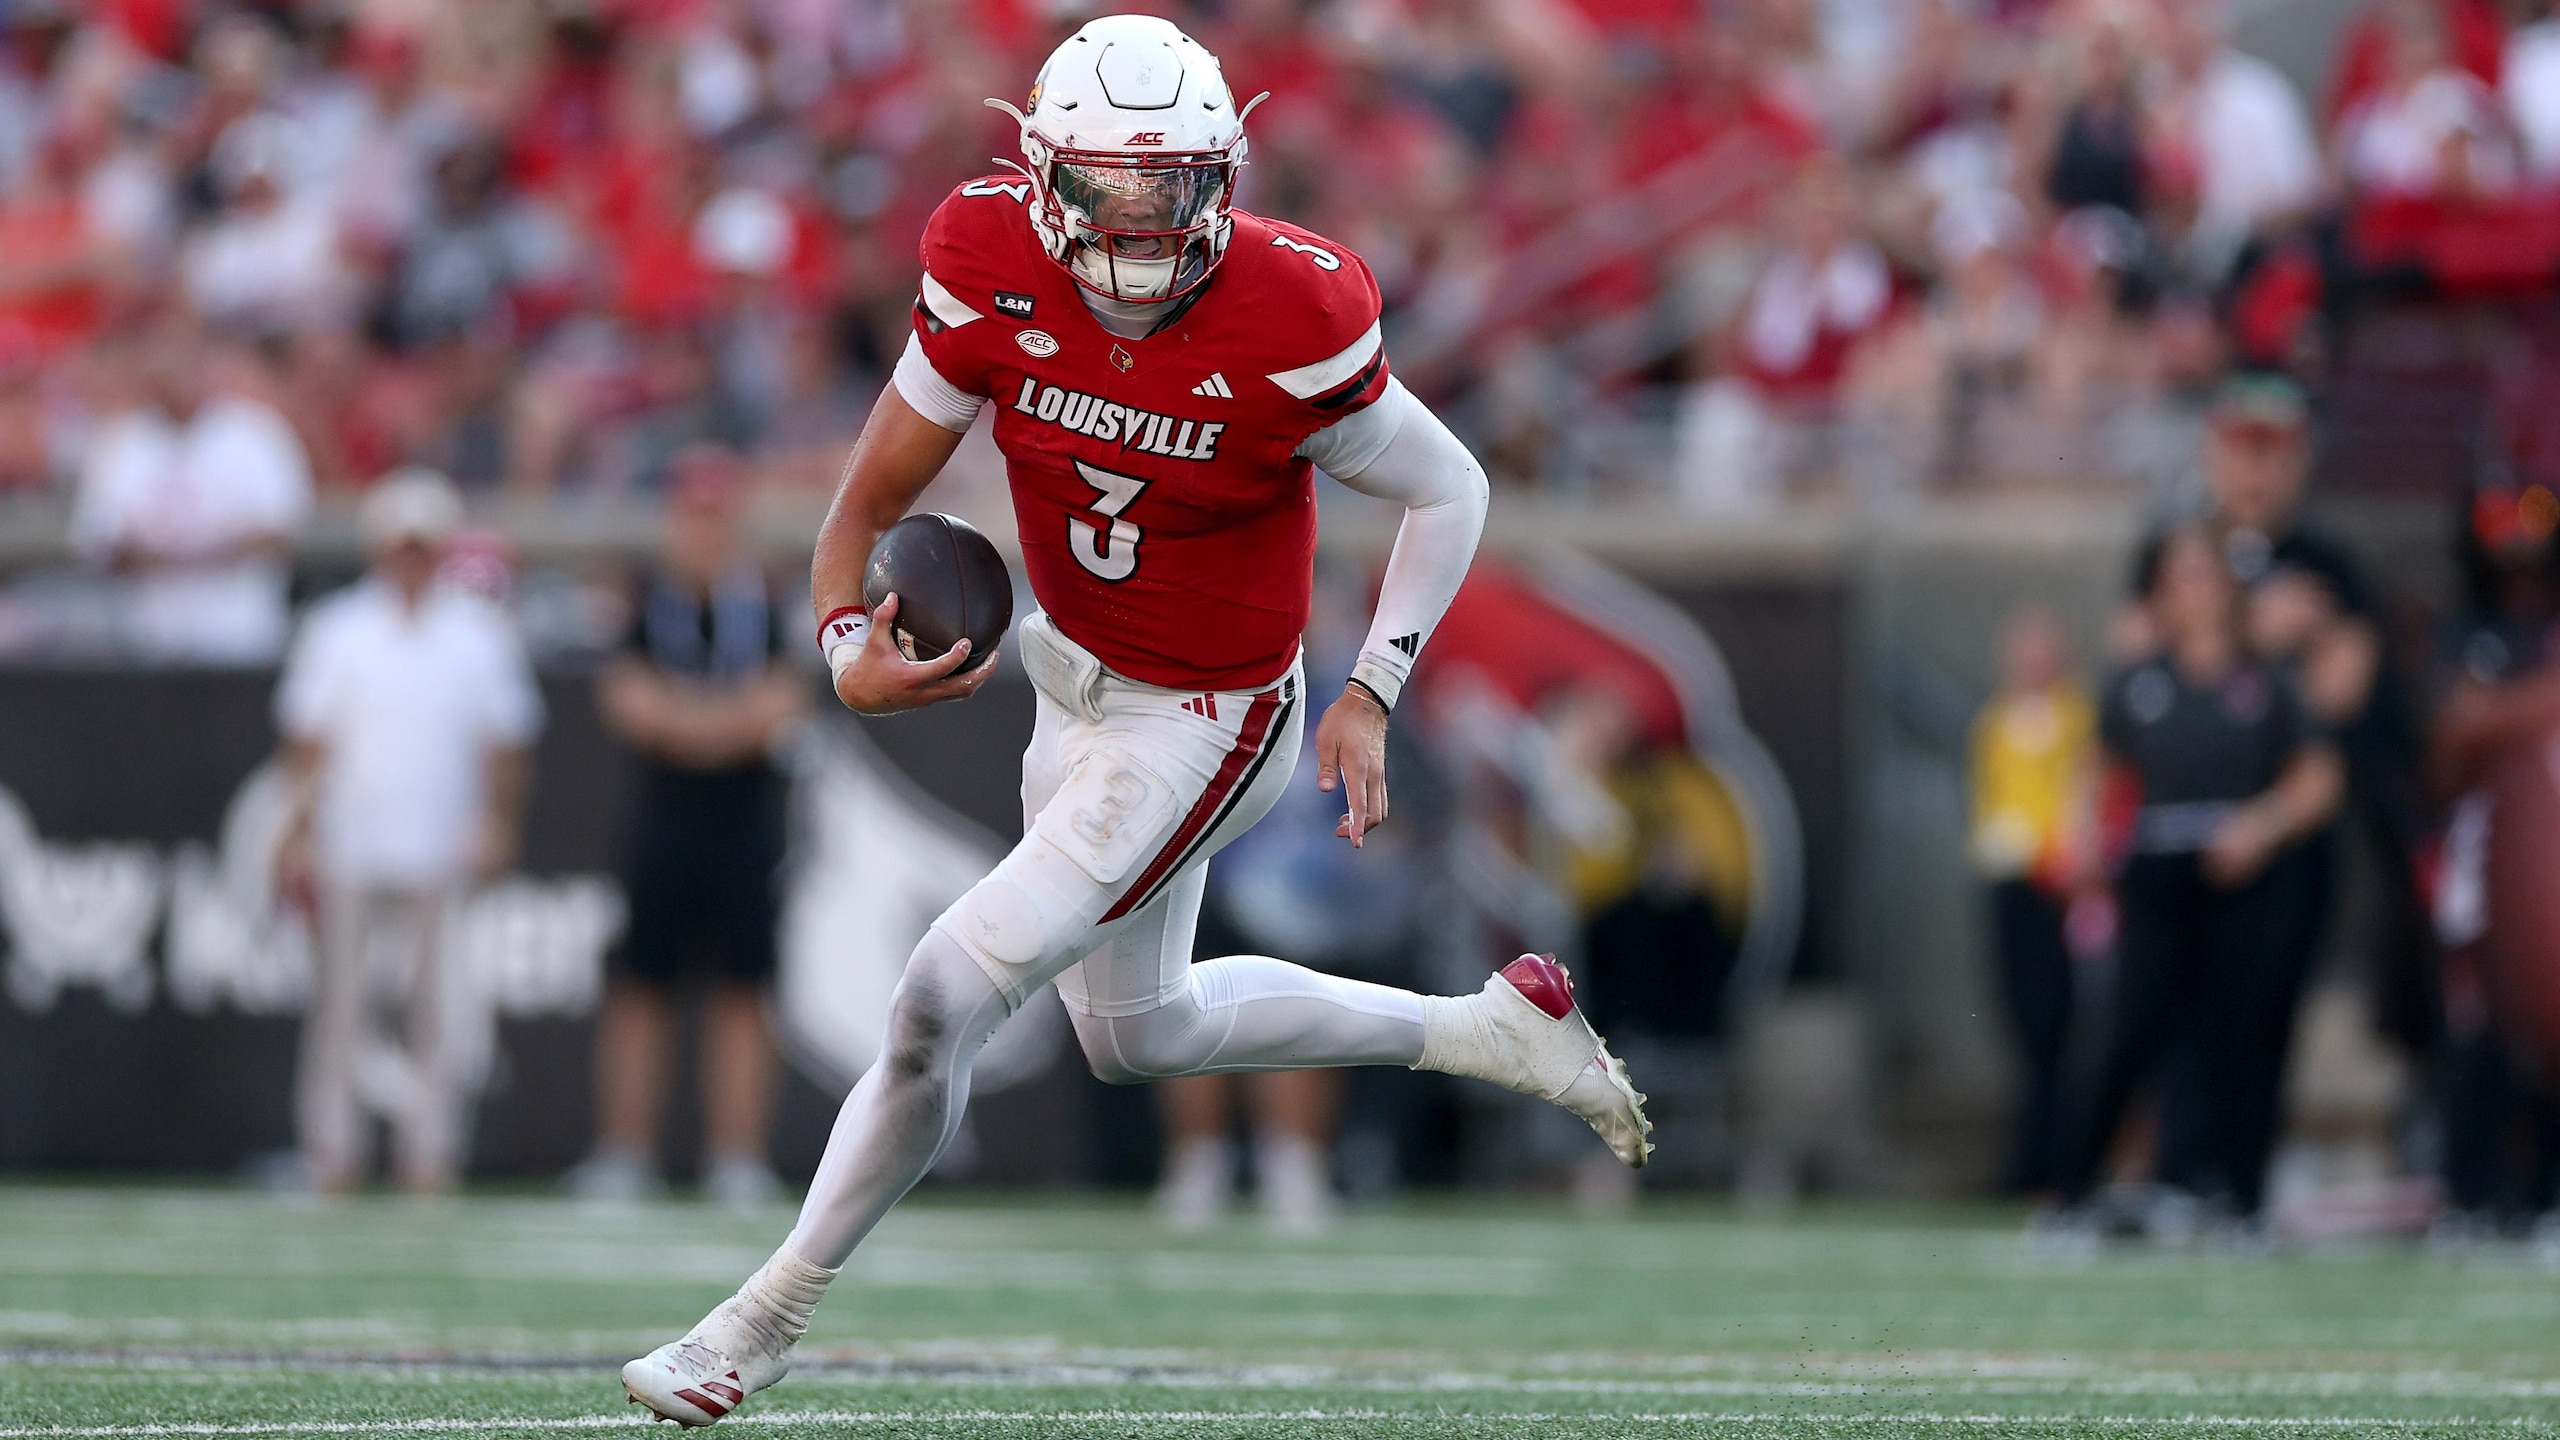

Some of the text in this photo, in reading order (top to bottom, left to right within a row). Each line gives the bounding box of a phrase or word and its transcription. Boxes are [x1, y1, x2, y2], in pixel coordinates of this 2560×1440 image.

[1124, 132, 1165, 145] ACC
[1270, 234, 1341, 271] 3
[995, 296, 1032, 312] L&N
[1024, 336, 1052, 349] ACC
[1013, 376, 1227, 462] LOUISVILLE
[1066, 457, 1150, 583] 3
